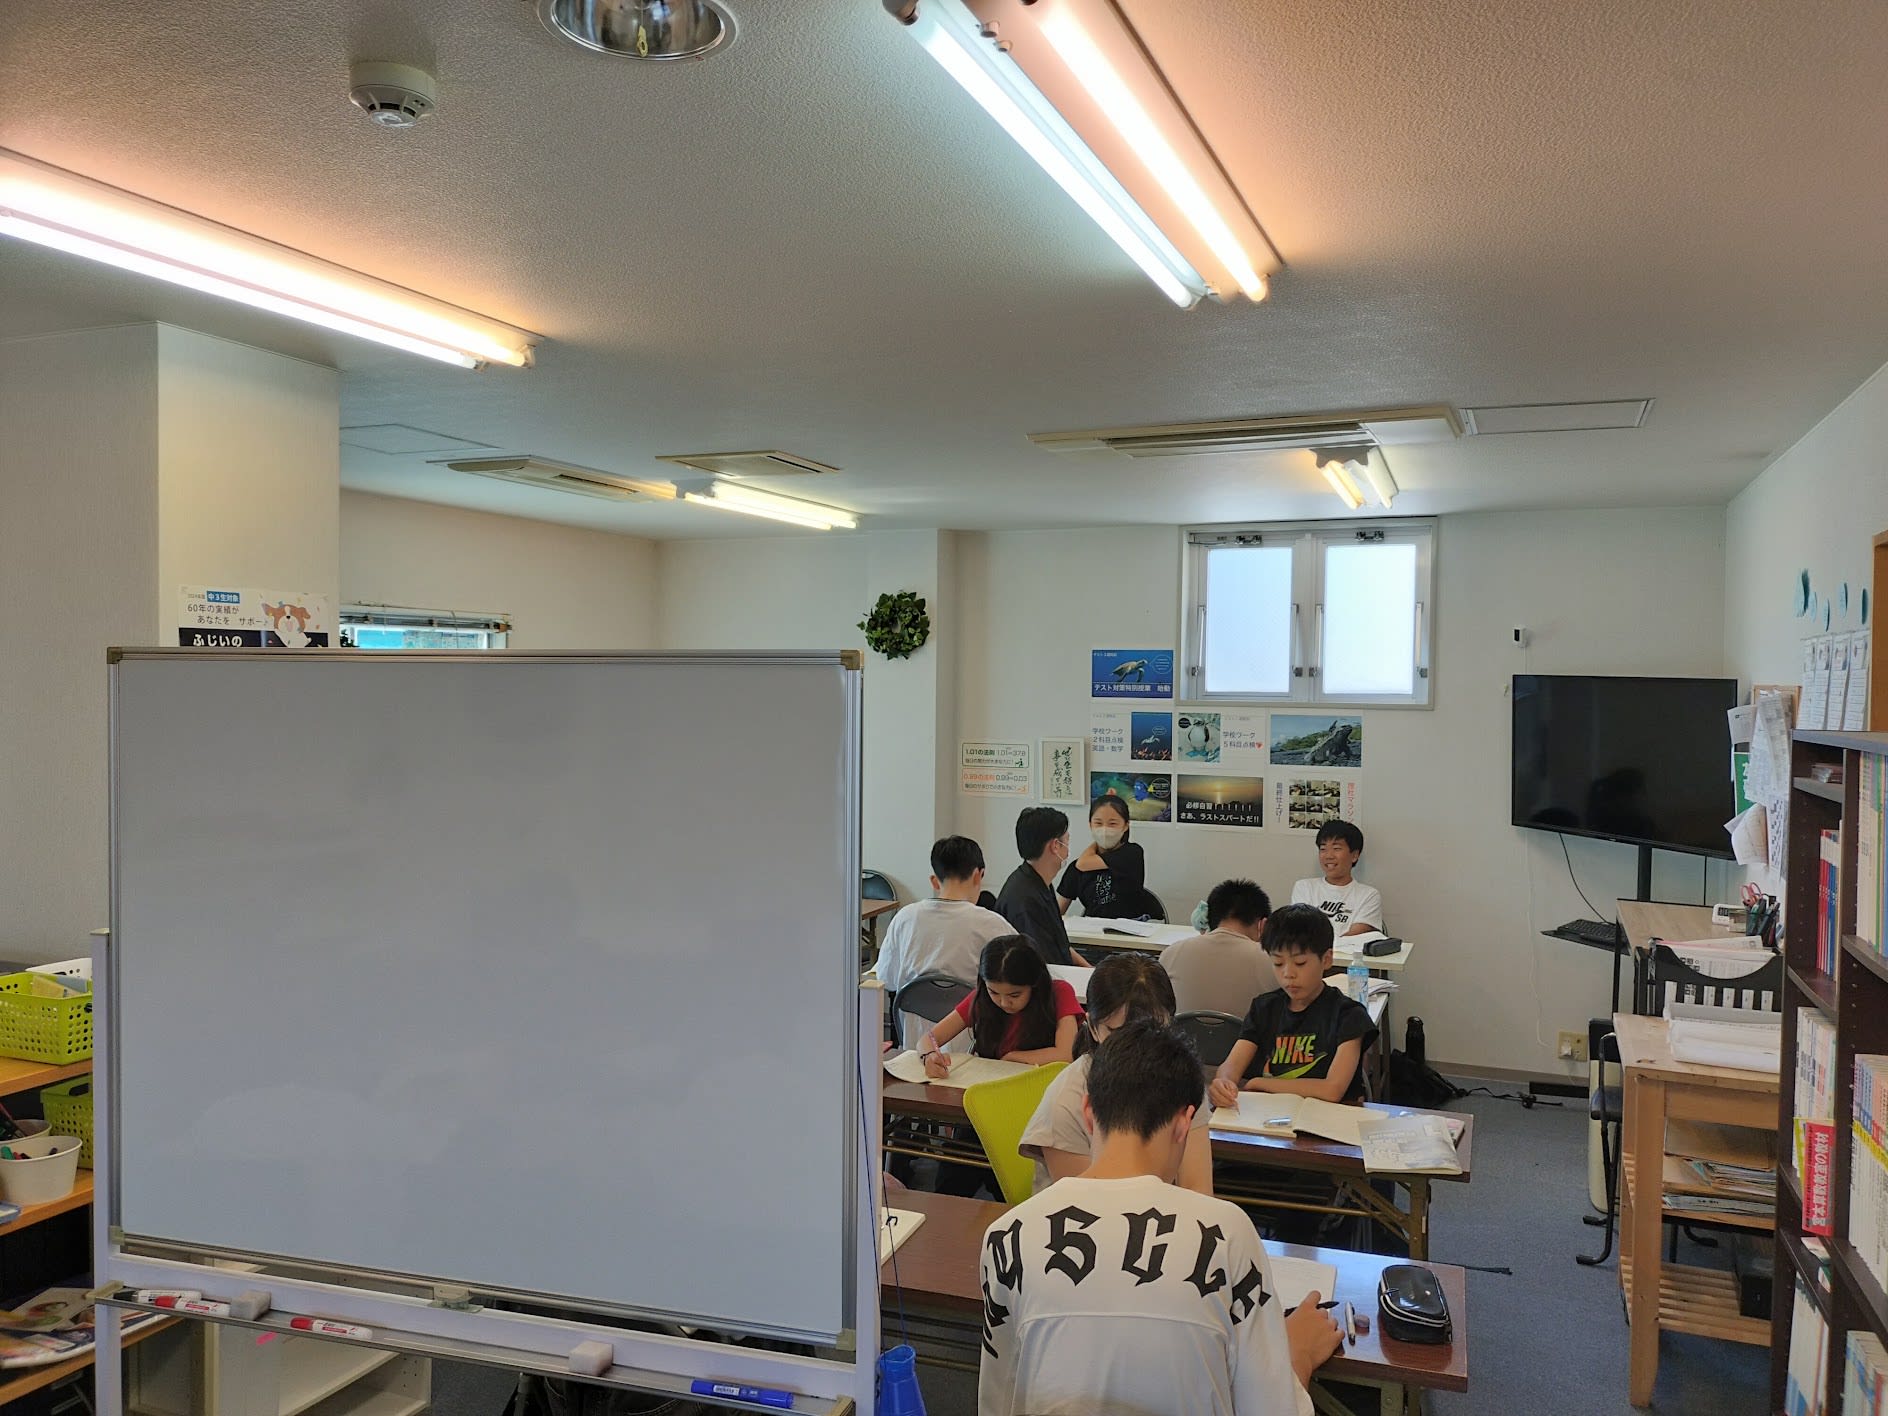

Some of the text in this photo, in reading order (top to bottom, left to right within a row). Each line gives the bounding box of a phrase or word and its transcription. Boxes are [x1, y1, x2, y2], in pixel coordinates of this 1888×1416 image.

[187, 603, 240, 615] 60年の実績が
[197, 615, 230, 625] あなたを
[192, 633, 243, 647] ふじいの
[1335, 914, 1349, 923] SB
[1272, 1034, 1317, 1064] NIKE
